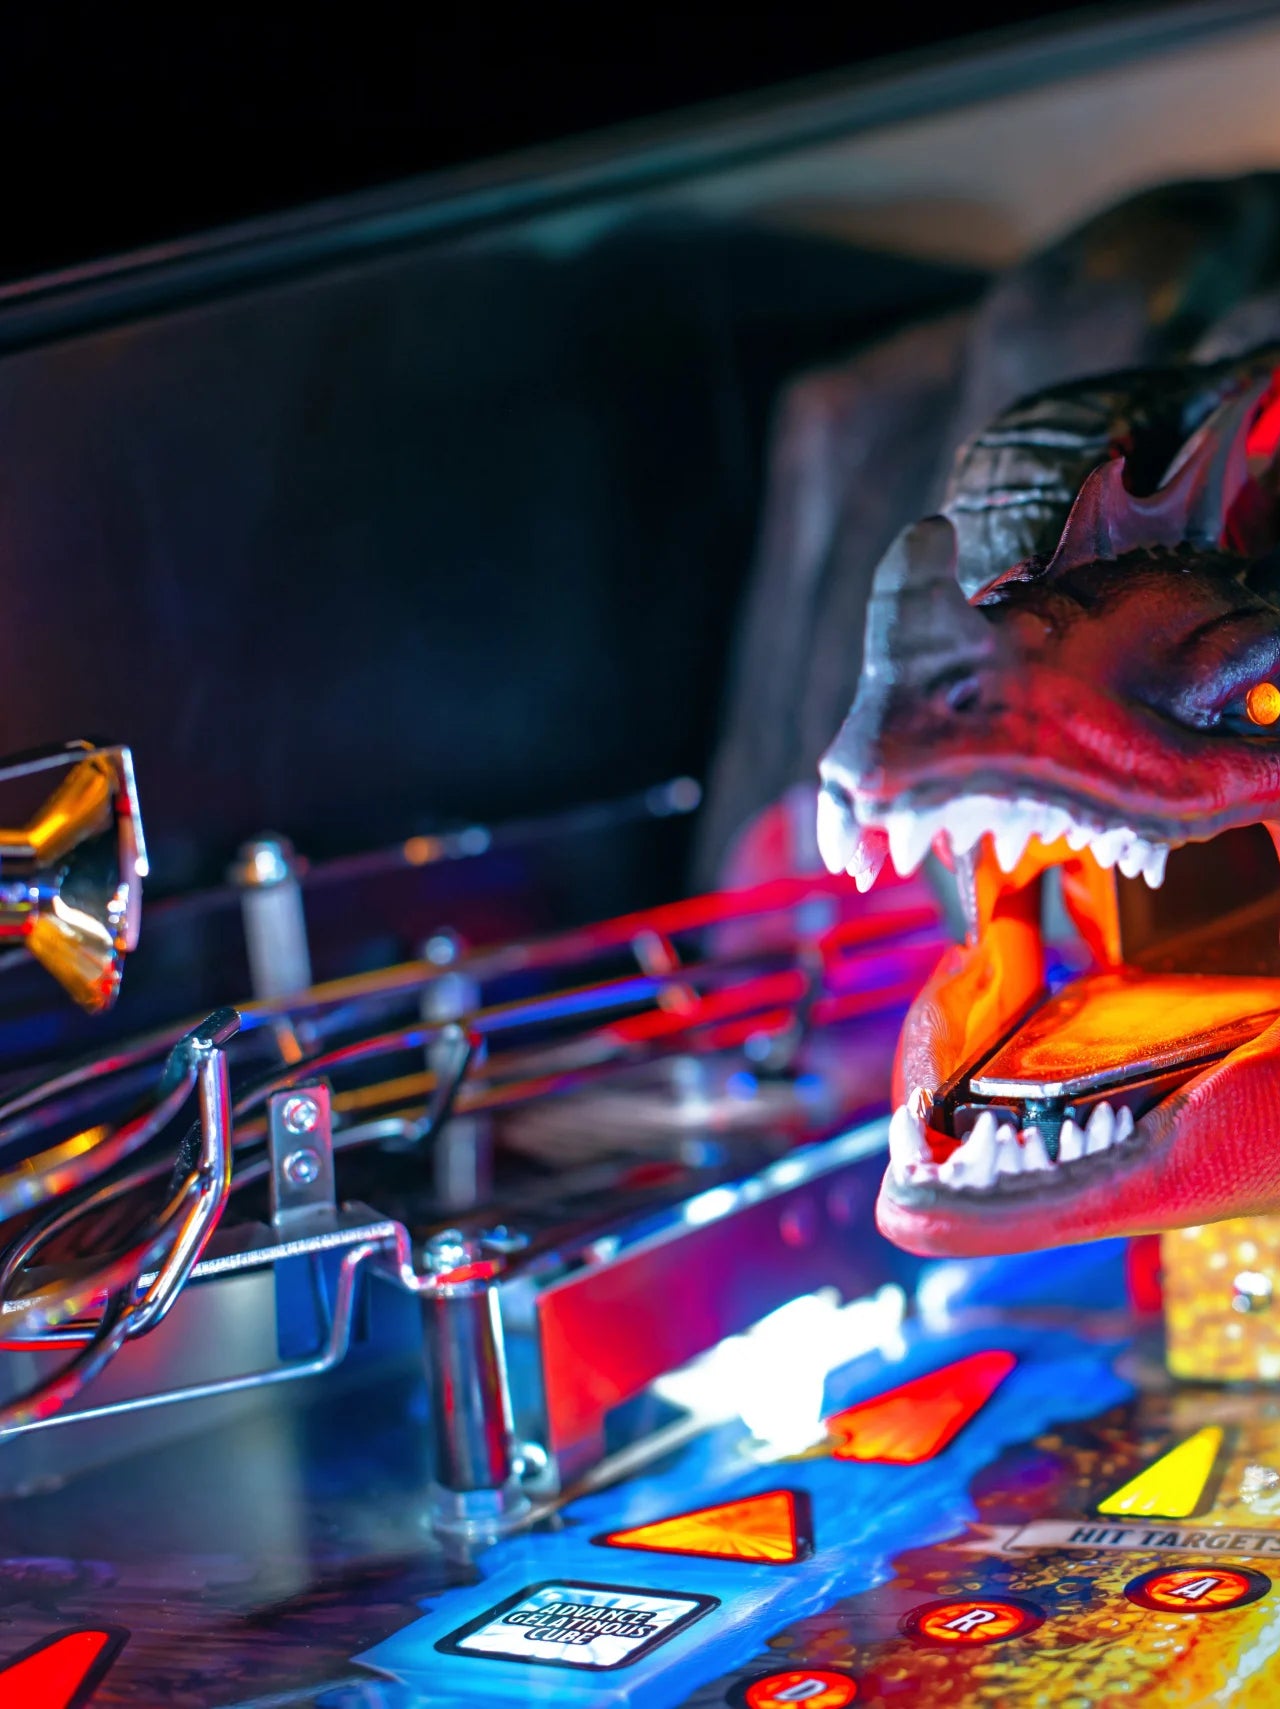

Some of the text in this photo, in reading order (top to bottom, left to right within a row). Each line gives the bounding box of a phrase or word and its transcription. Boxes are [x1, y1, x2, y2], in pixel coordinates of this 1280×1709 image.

[1068, 1527, 1136, 1546] HIT
[1169, 1576, 1222, 1600] A
[508, 1612, 653, 1637] GELATINOUS
[542, 1602, 652, 1625] ADVANCE
[942, 1608, 996, 1632] R
[529, 1627, 595, 1645] CUBE
[773, 1678, 828, 1701] D
